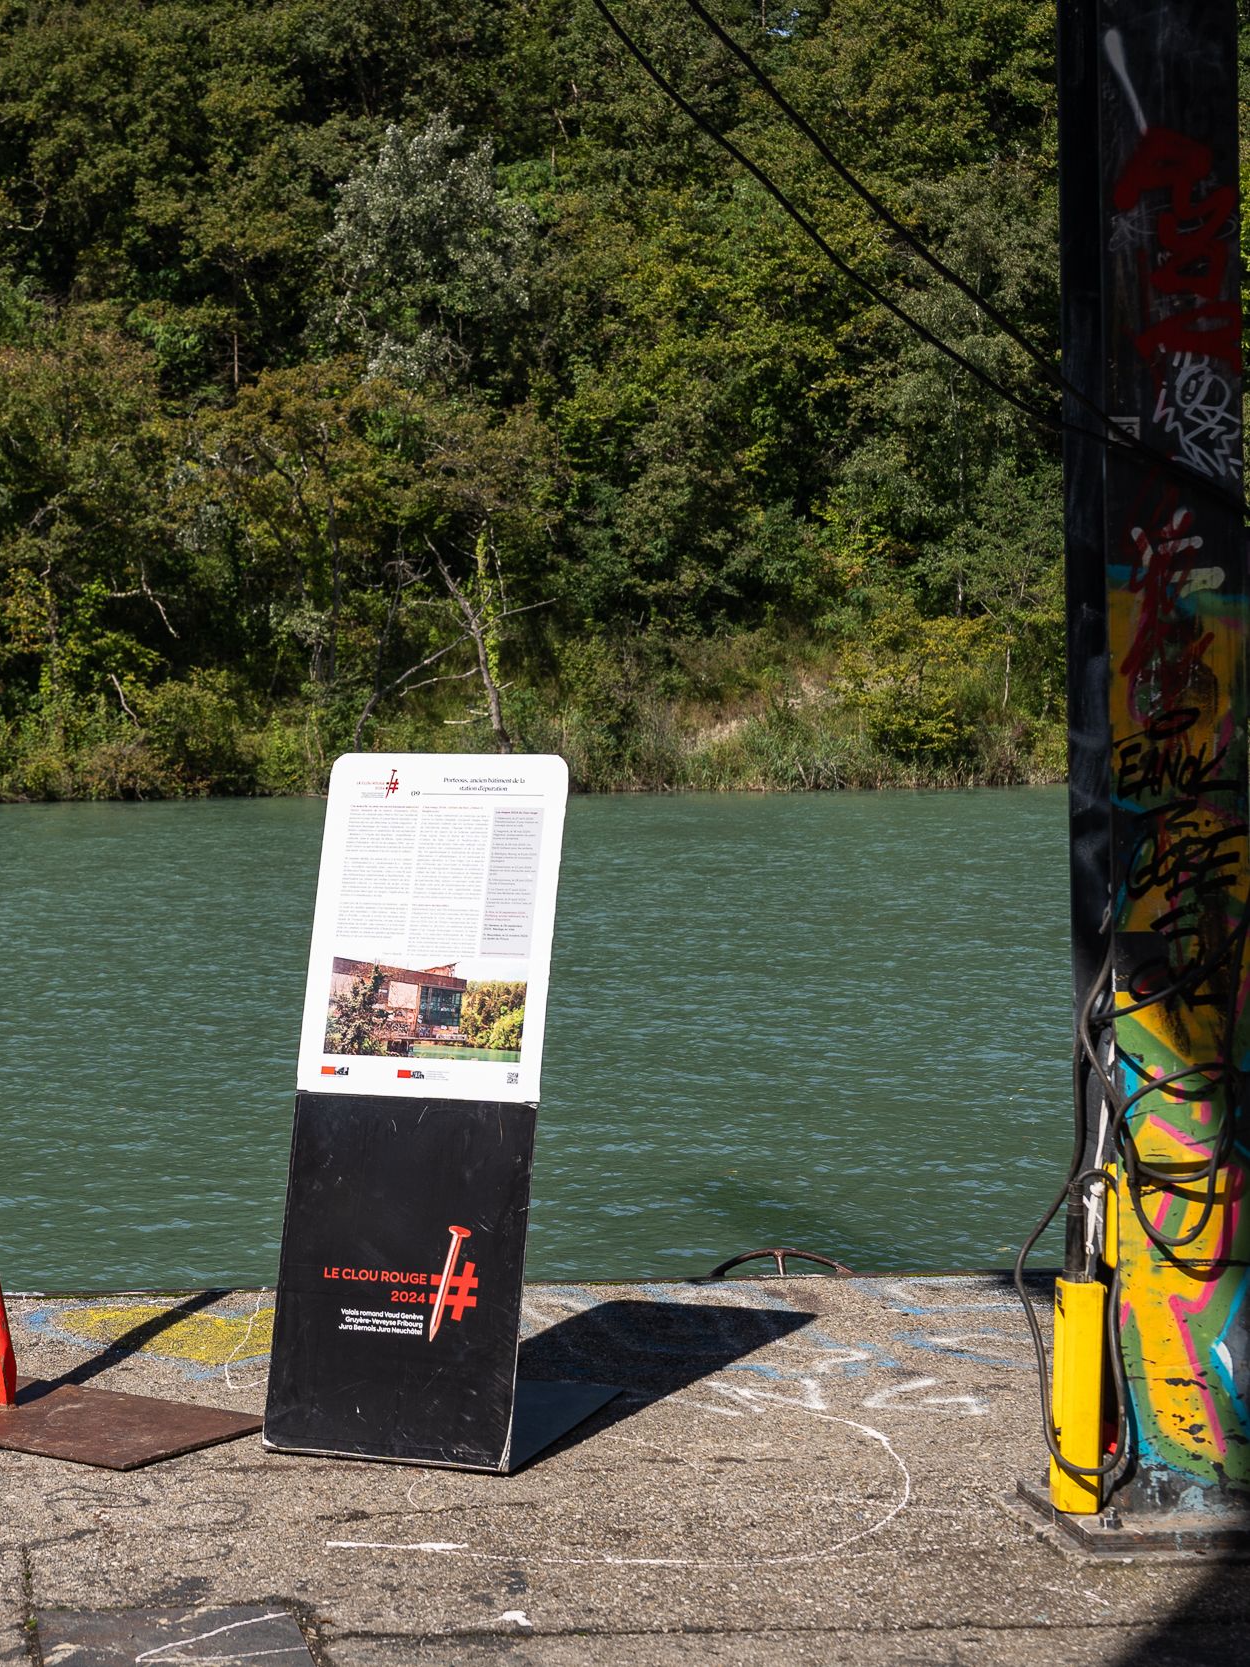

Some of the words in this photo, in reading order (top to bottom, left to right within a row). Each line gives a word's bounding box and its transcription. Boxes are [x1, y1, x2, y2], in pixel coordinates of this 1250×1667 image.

[323, 1267, 340, 1279] LE
[341, 1268, 379, 1282] CLOU
[380, 1270, 428, 1285] ROUGE
[390, 1290, 426, 1304] 2024
[340, 1308, 359, 1316] Valais
[359, 1310, 384, 1318] romand
[384, 1311, 400, 1319] Vaud
[400, 1312, 424, 1321] Genève
[353, 1324, 376, 1332] Bernois
[376, 1325, 391, 1333] Jura
[391, 1327, 423, 1336] Neuchâtel
[396, 1319, 424, 1329] Fribourg
